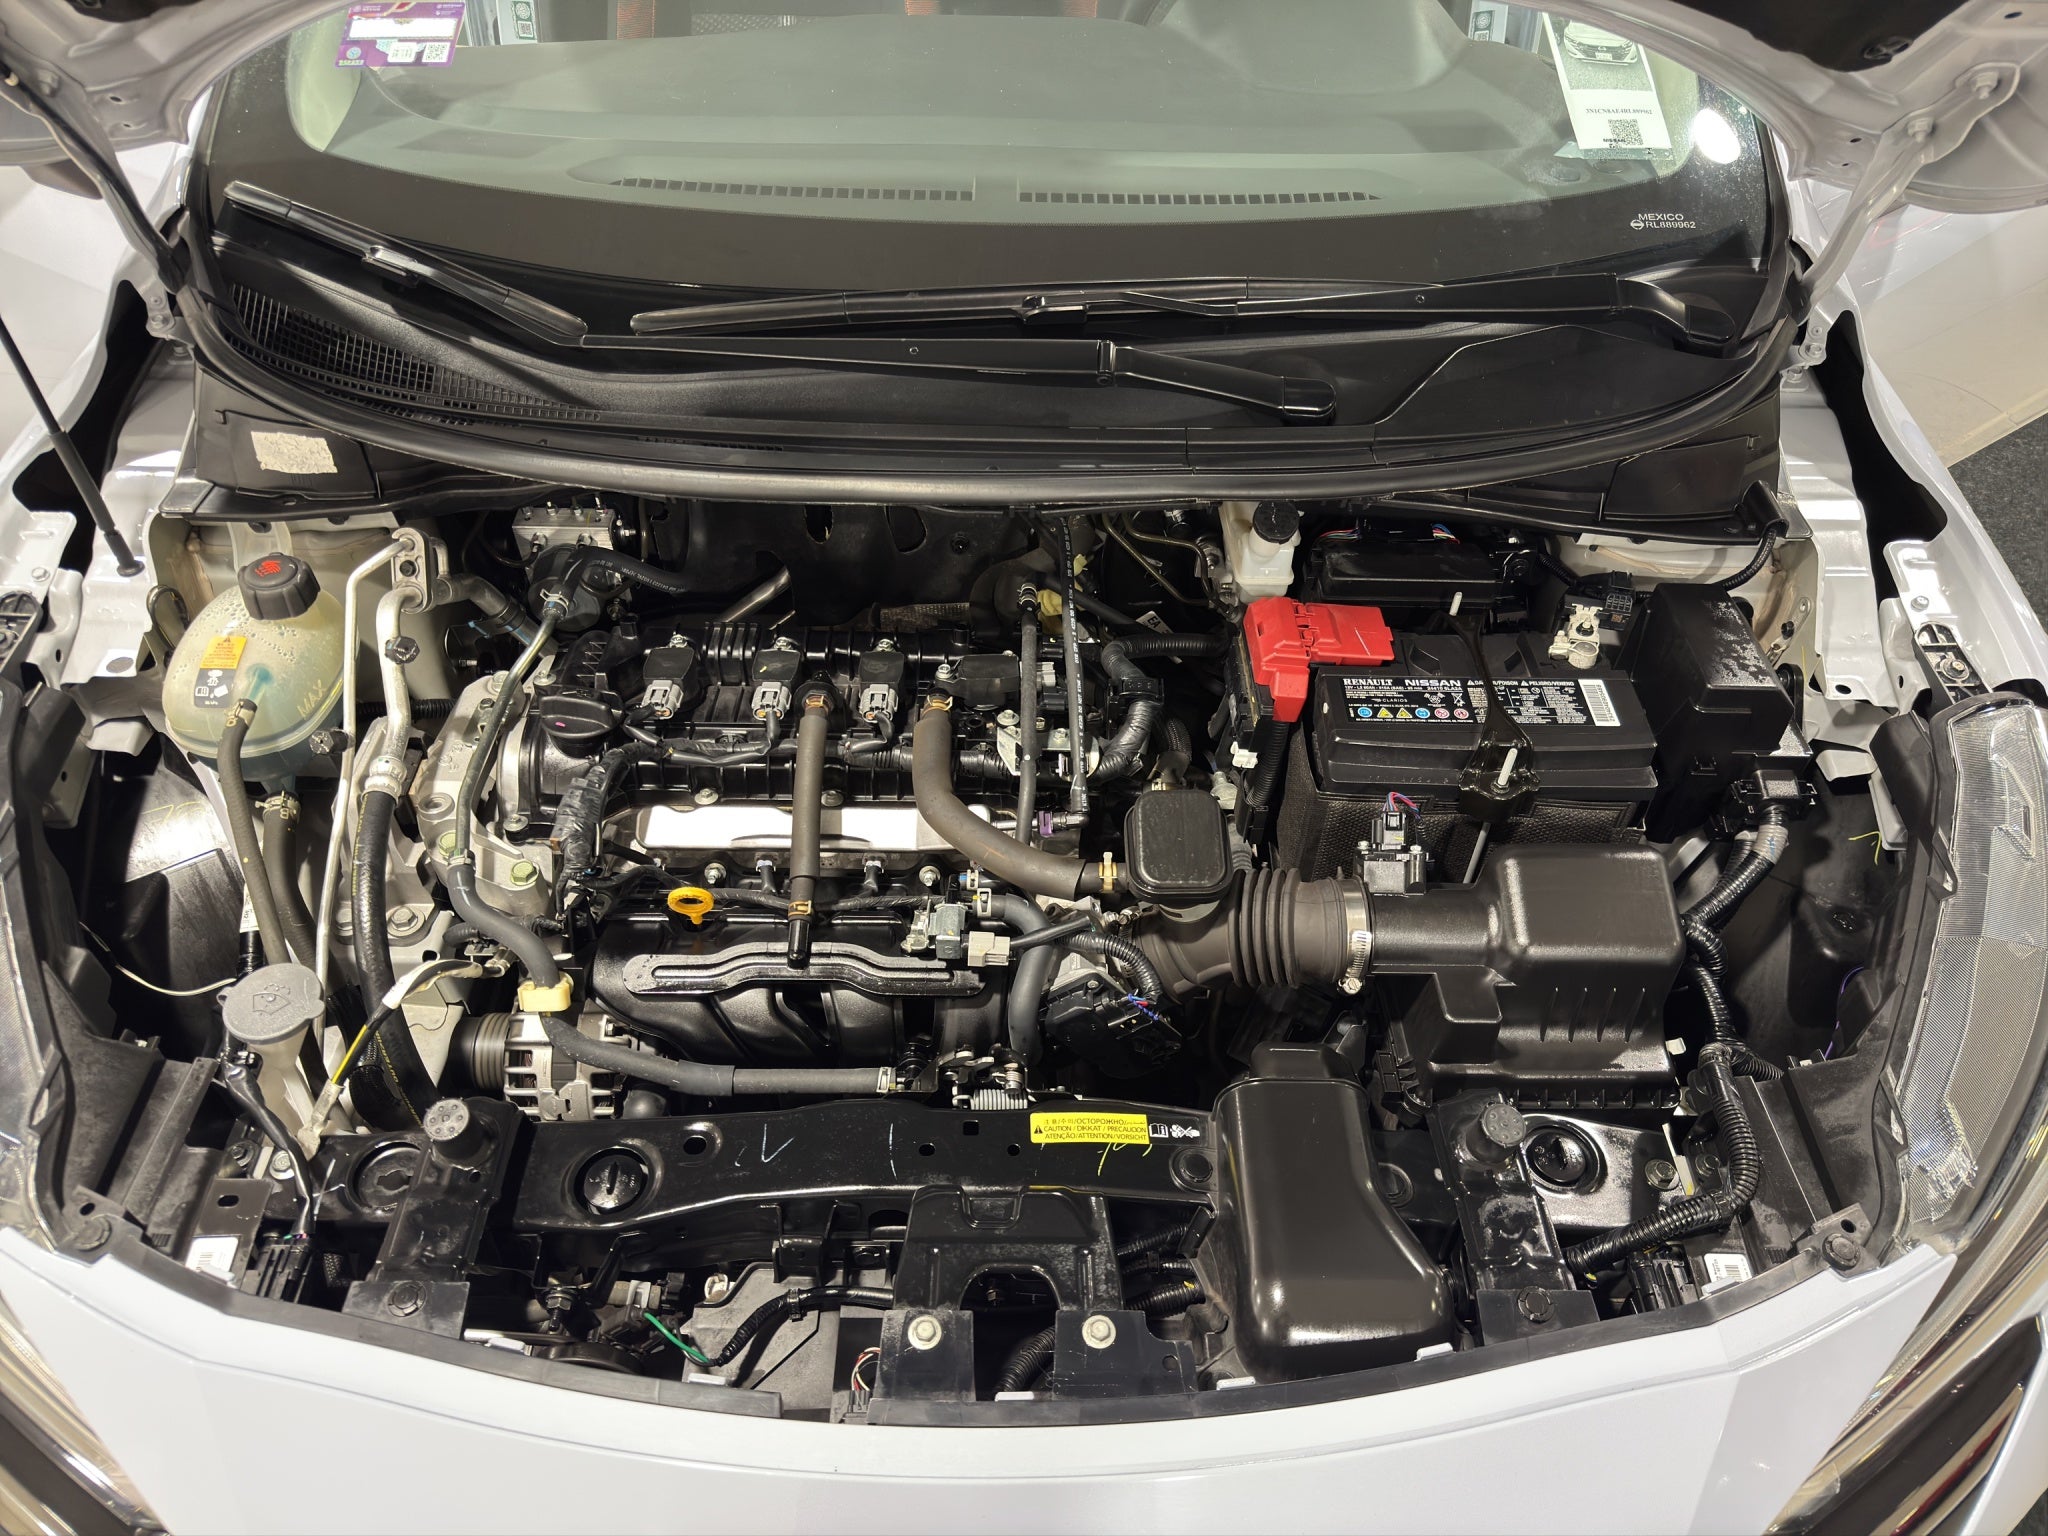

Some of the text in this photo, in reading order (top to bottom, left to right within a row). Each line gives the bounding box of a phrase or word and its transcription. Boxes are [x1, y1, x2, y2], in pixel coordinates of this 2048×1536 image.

[1637, 213, 1684, 221] MEXICO
[1645, 221, 1697, 229] RL889962
[1343, 678, 1461, 687] RENAULT NISSAN
[296, 679, 326, 721] MAX
